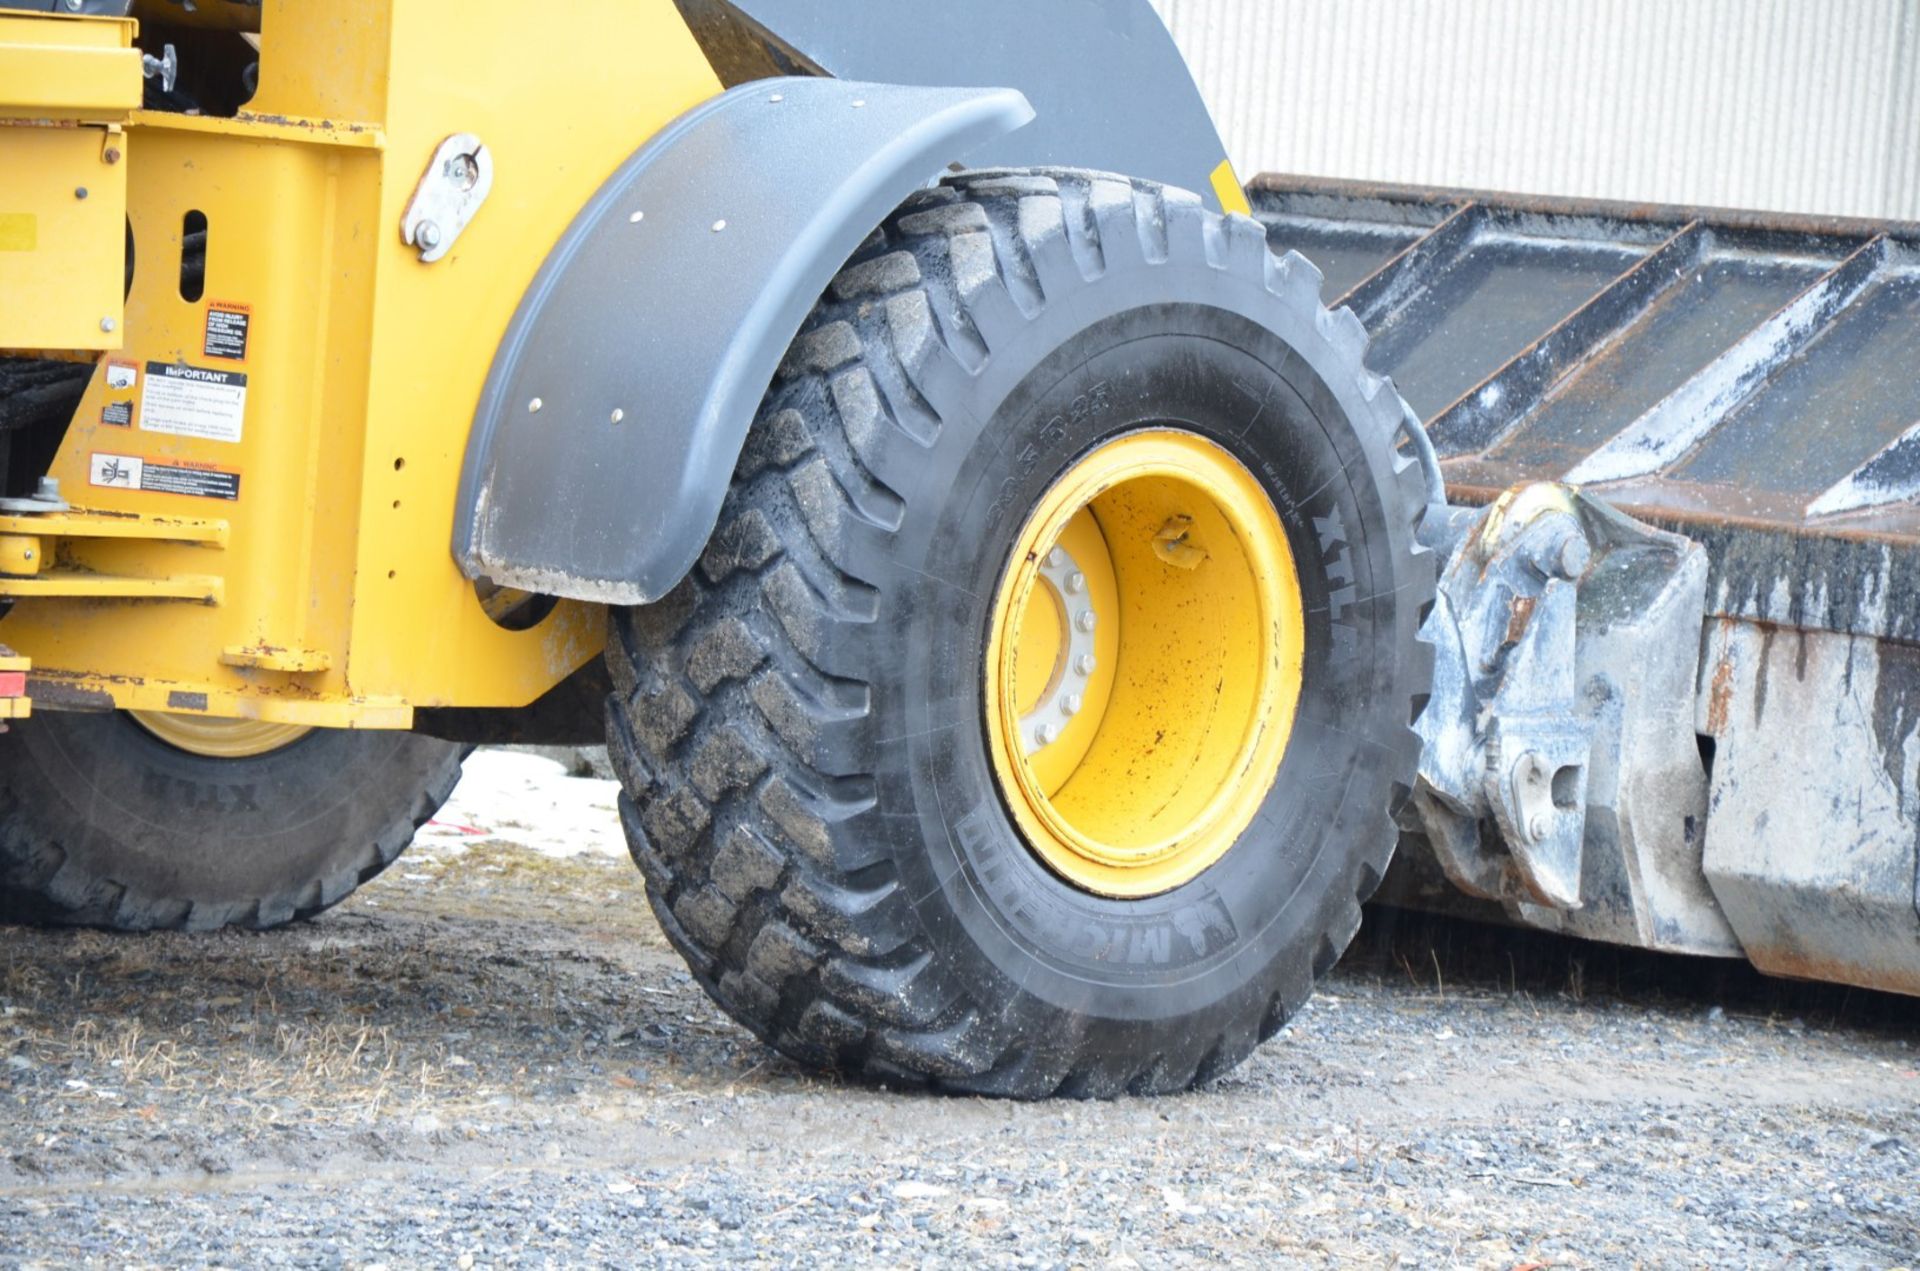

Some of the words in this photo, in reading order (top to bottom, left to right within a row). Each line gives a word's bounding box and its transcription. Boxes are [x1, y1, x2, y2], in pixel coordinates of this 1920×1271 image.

[215, 302, 249, 311] WARNING
[165, 366, 229, 383] IMPORTANT
[183, 461, 218, 471] WARNING
